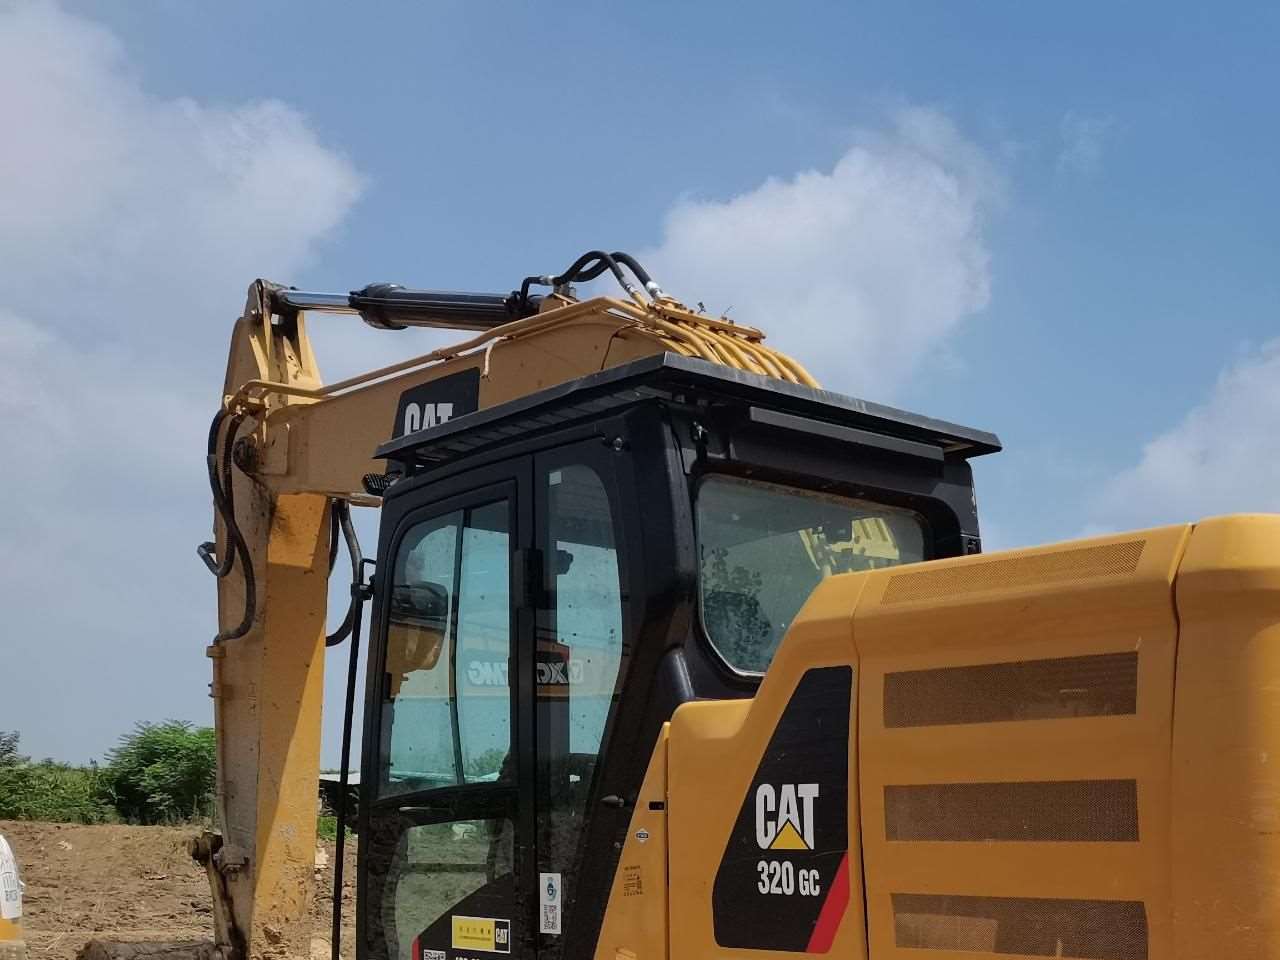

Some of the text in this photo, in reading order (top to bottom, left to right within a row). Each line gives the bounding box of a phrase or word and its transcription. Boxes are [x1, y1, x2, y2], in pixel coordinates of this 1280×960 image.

[756, 783, 819, 850] CAT
[757, 860, 820, 896] 320 GC
[496, 928, 508, 944] CAT
